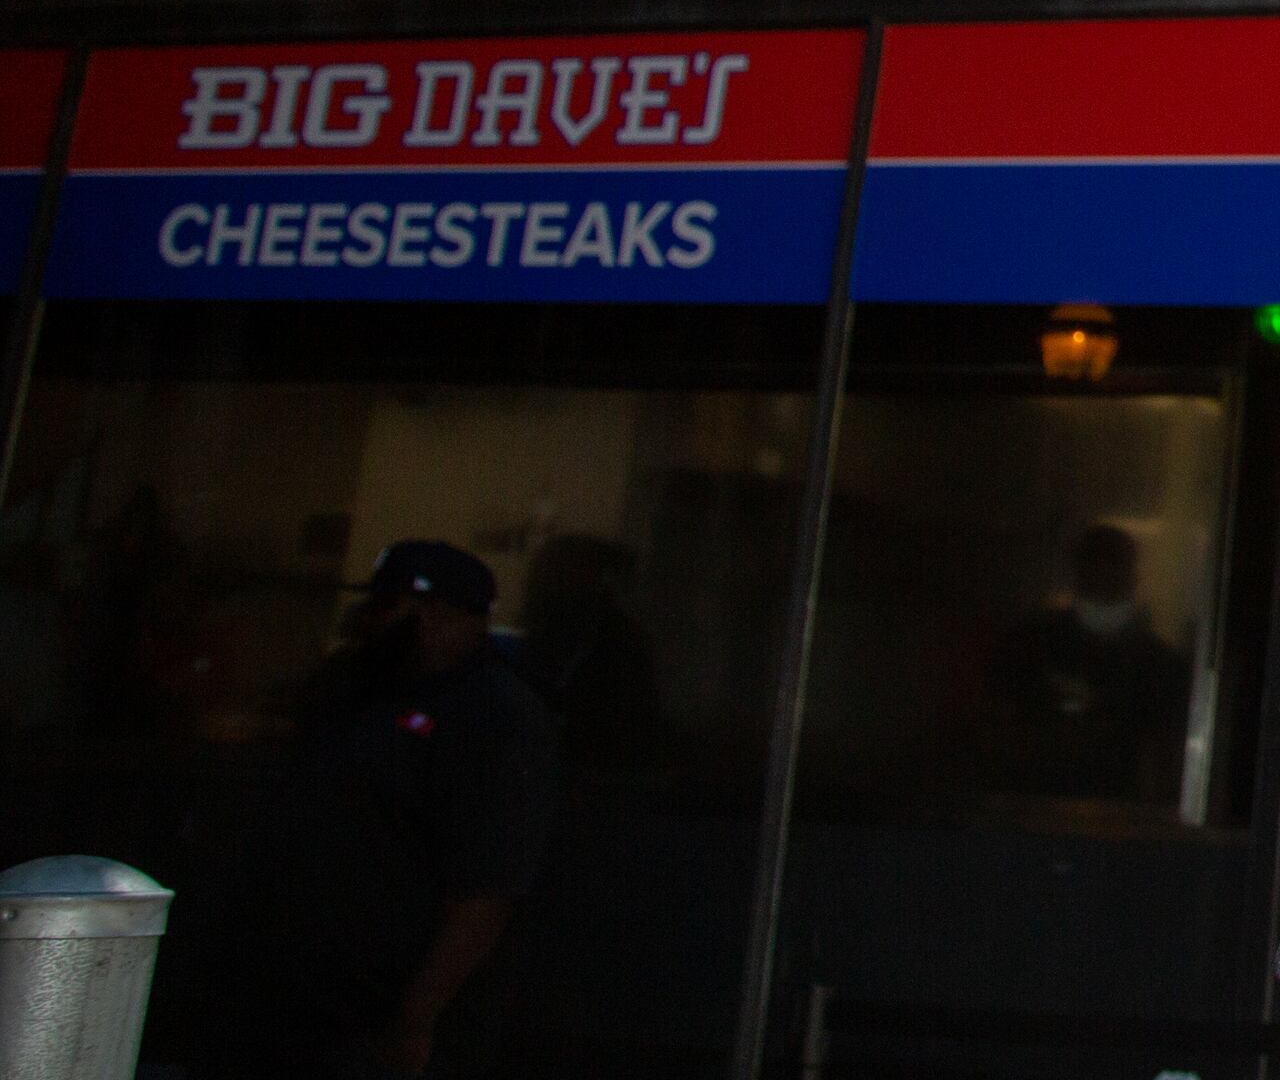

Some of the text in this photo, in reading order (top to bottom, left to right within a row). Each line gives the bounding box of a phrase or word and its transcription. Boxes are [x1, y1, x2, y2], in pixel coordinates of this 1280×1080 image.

[178, 52, 748, 148] BIG DAVE'S
[158, 199, 718, 269] CHEESESTEAKS
